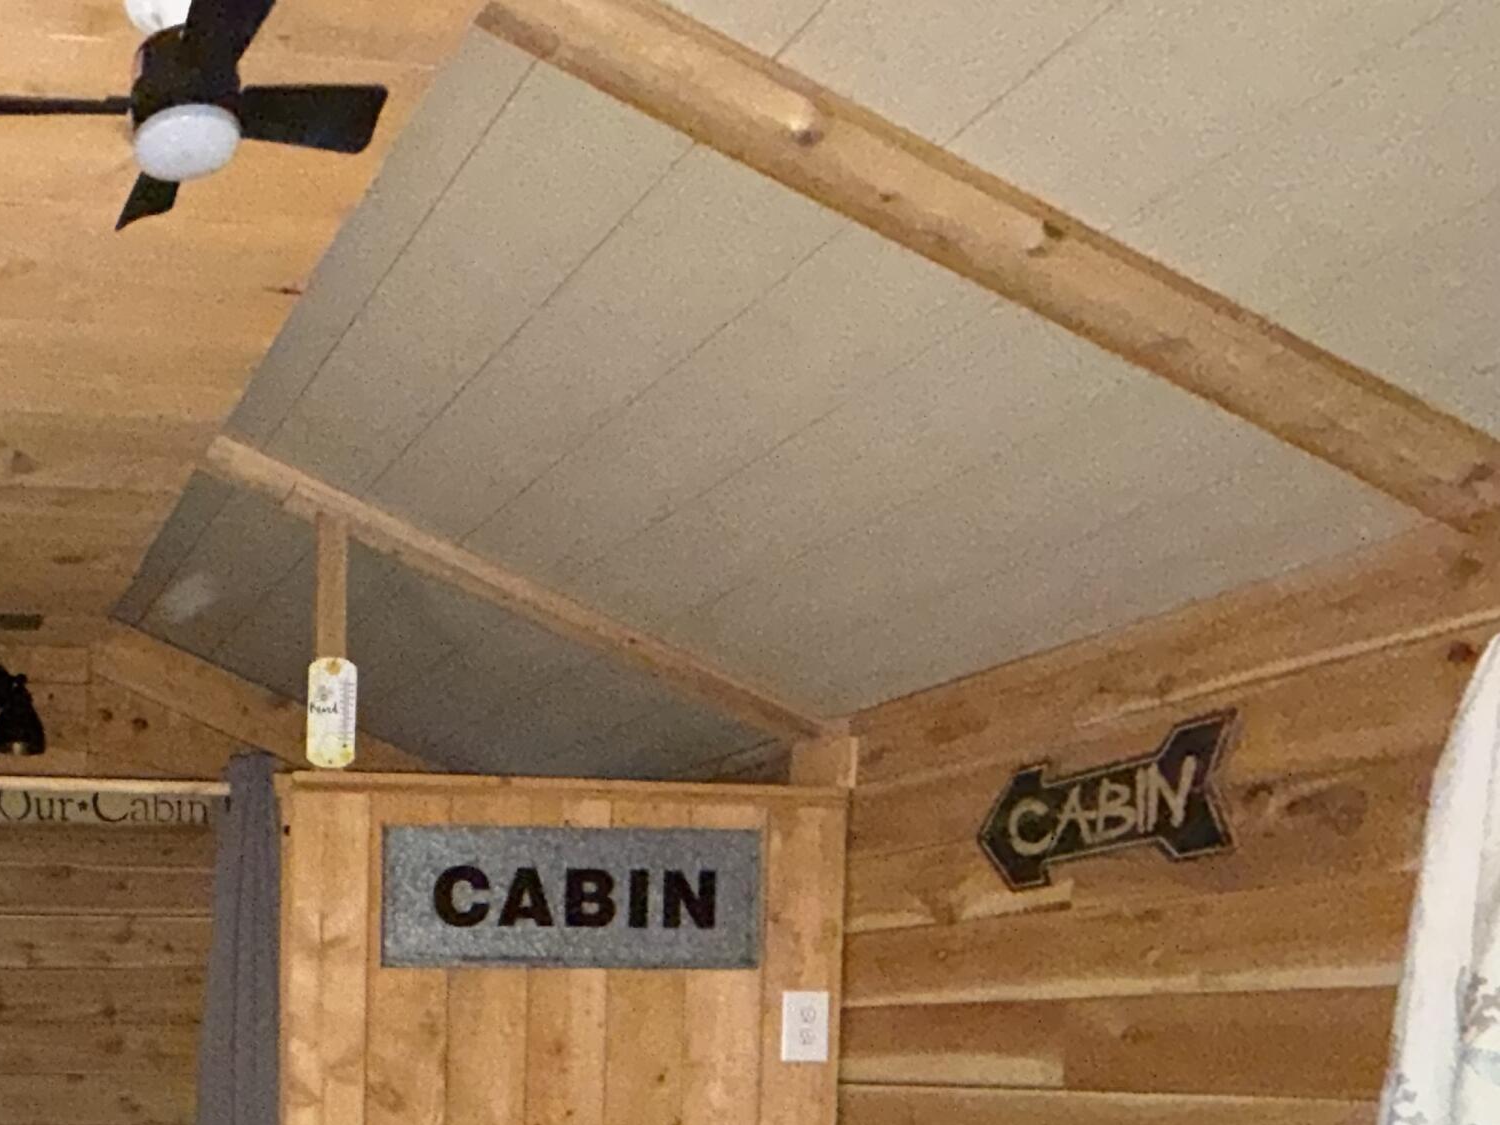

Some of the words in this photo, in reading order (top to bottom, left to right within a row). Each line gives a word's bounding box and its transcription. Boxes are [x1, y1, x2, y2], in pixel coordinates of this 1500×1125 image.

[92, 791, 211, 825] Cabin
[1008, 754, 1198, 856] CABIN
[432, 865, 718, 929] CABIN
